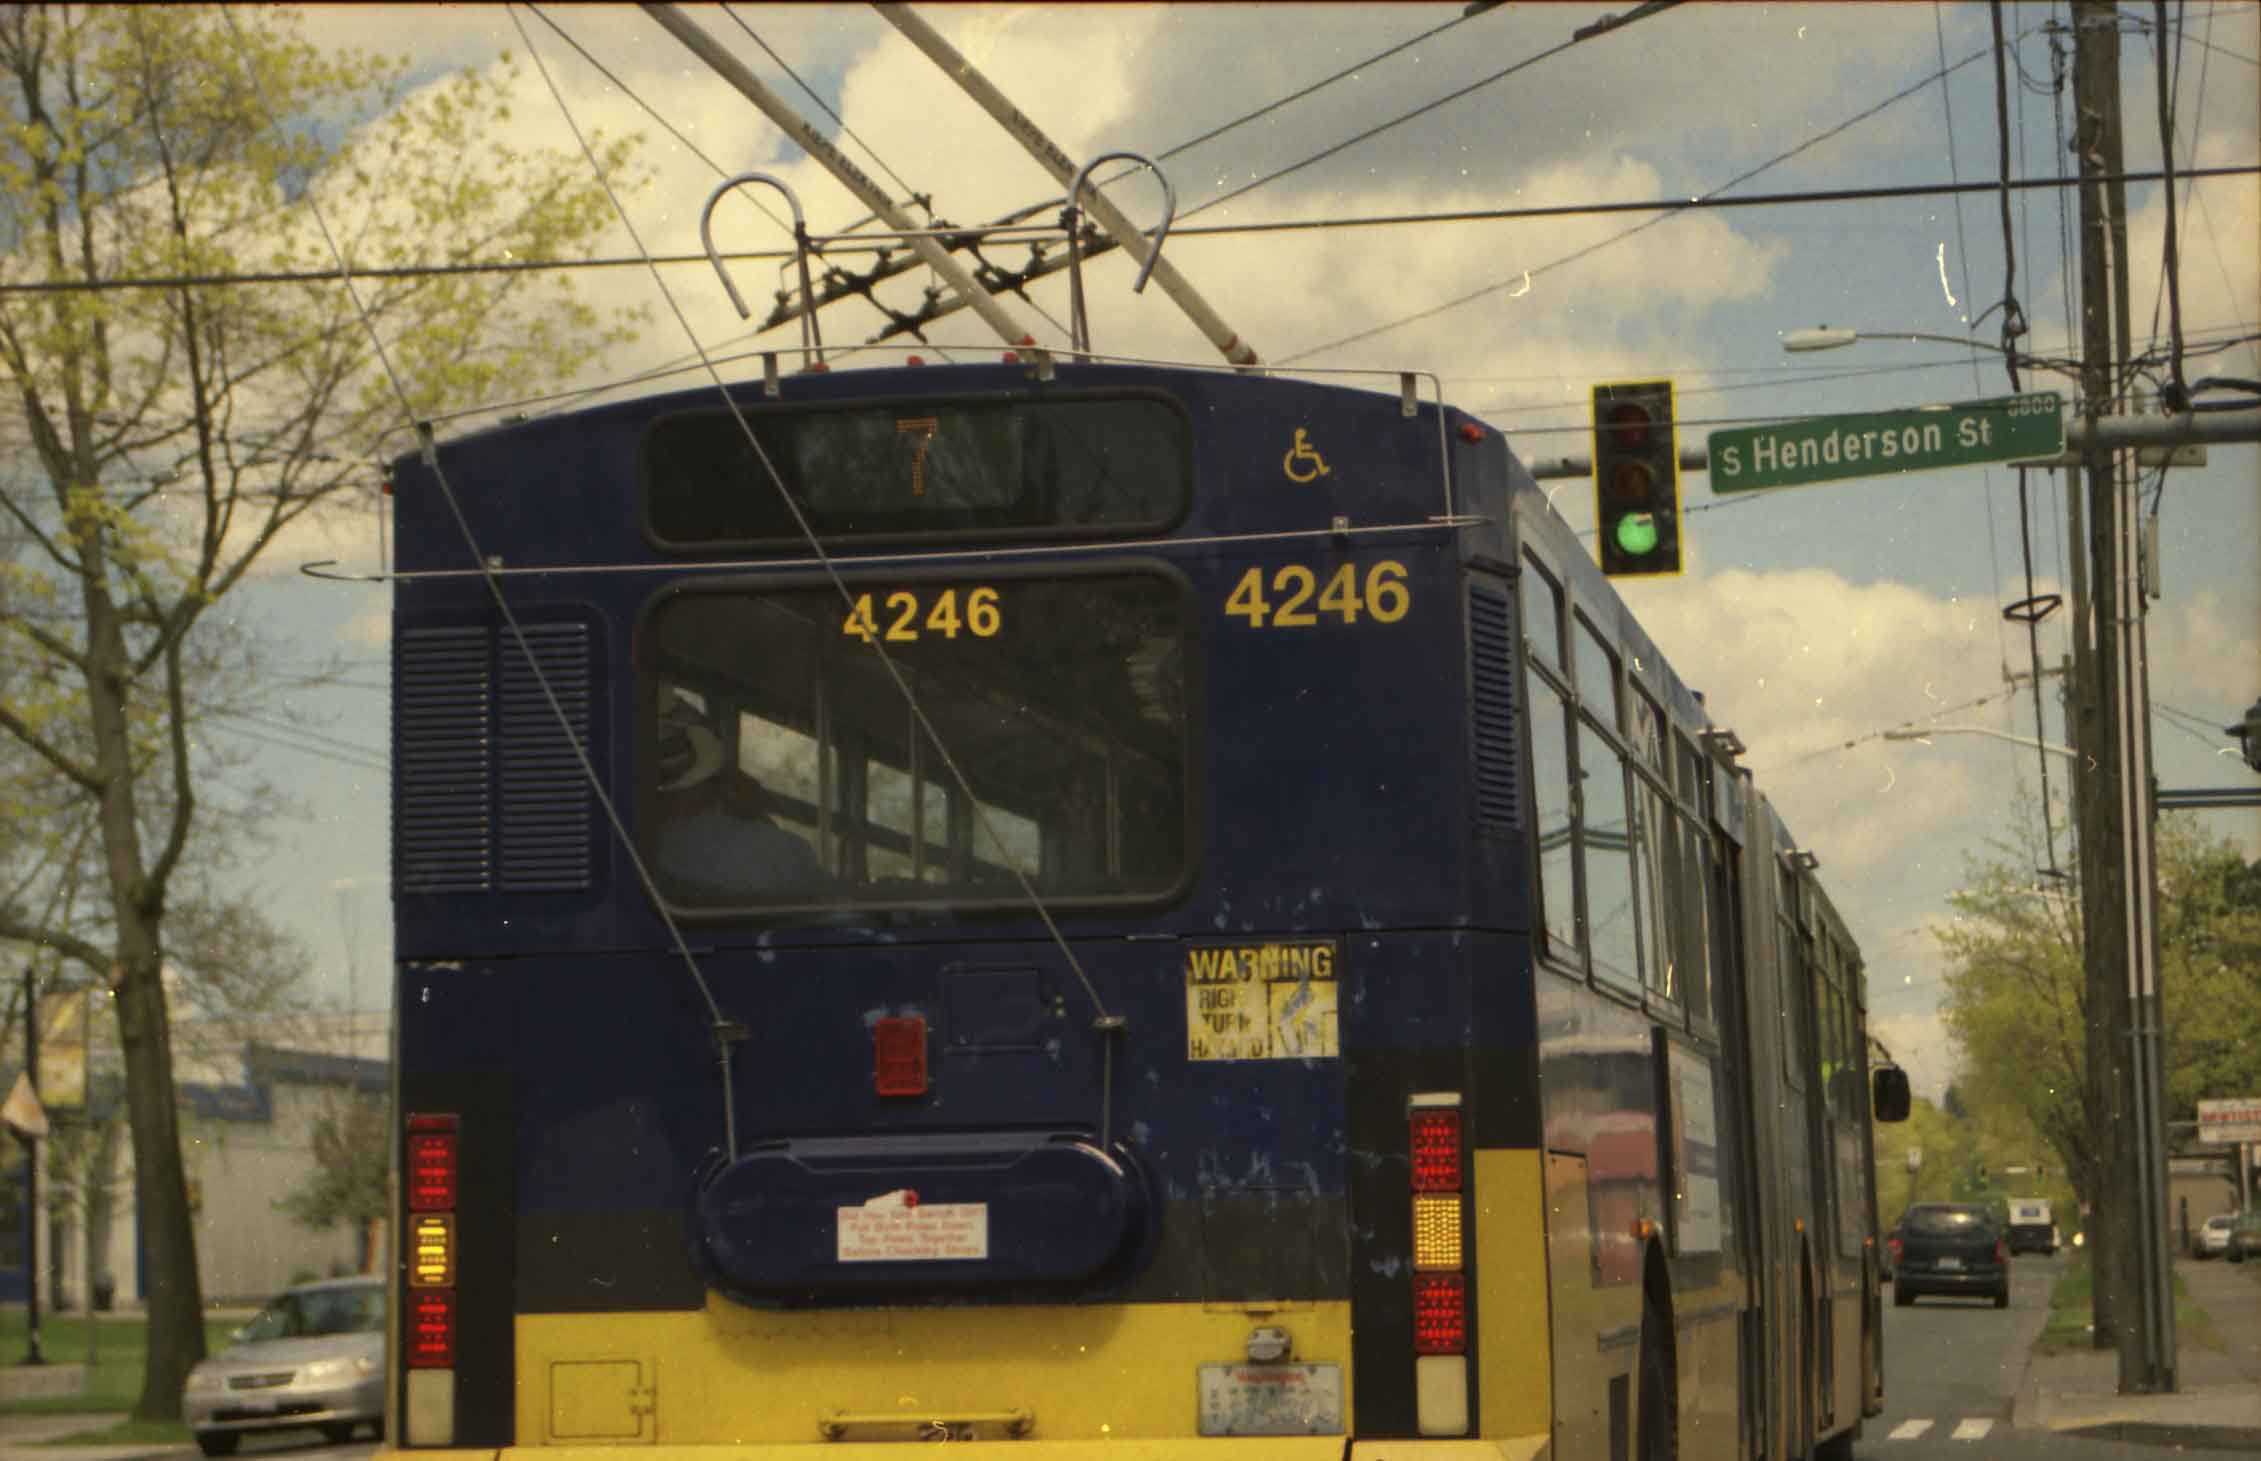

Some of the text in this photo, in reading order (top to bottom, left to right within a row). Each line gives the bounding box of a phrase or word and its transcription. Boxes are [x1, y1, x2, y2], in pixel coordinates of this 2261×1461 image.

[896, 416, 937, 495] 7
[1722, 416, 1993, 476] S Henderson St
[842, 586, 1001, 644] 4246
[1224, 560, 1411, 629] 4246
